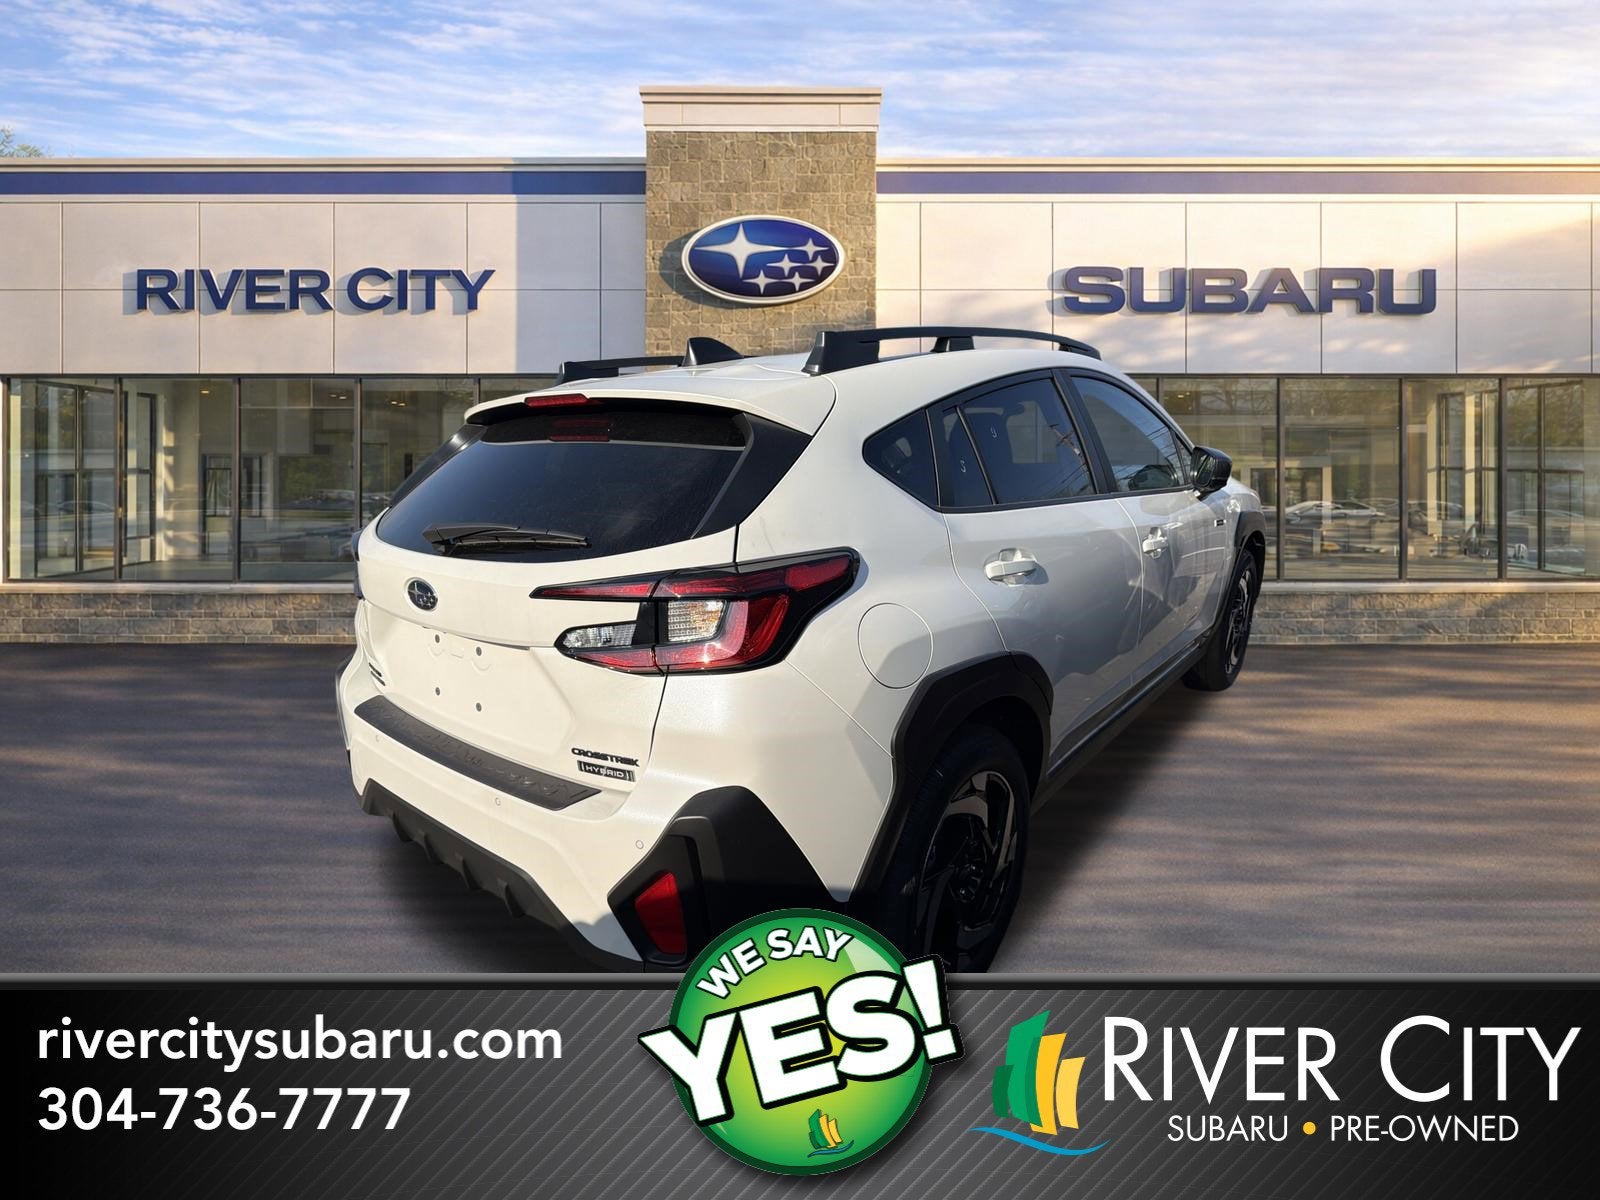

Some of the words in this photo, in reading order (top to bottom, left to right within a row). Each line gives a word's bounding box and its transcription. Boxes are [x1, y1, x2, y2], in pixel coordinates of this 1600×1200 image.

[136, 268, 332, 311] RIVER
[346, 267, 496, 311] CITY
[1063, 266, 1437, 315] SUBARU
[571, 747, 640, 767] CROSSTREK
[585, 765, 625, 778] HYBRID
